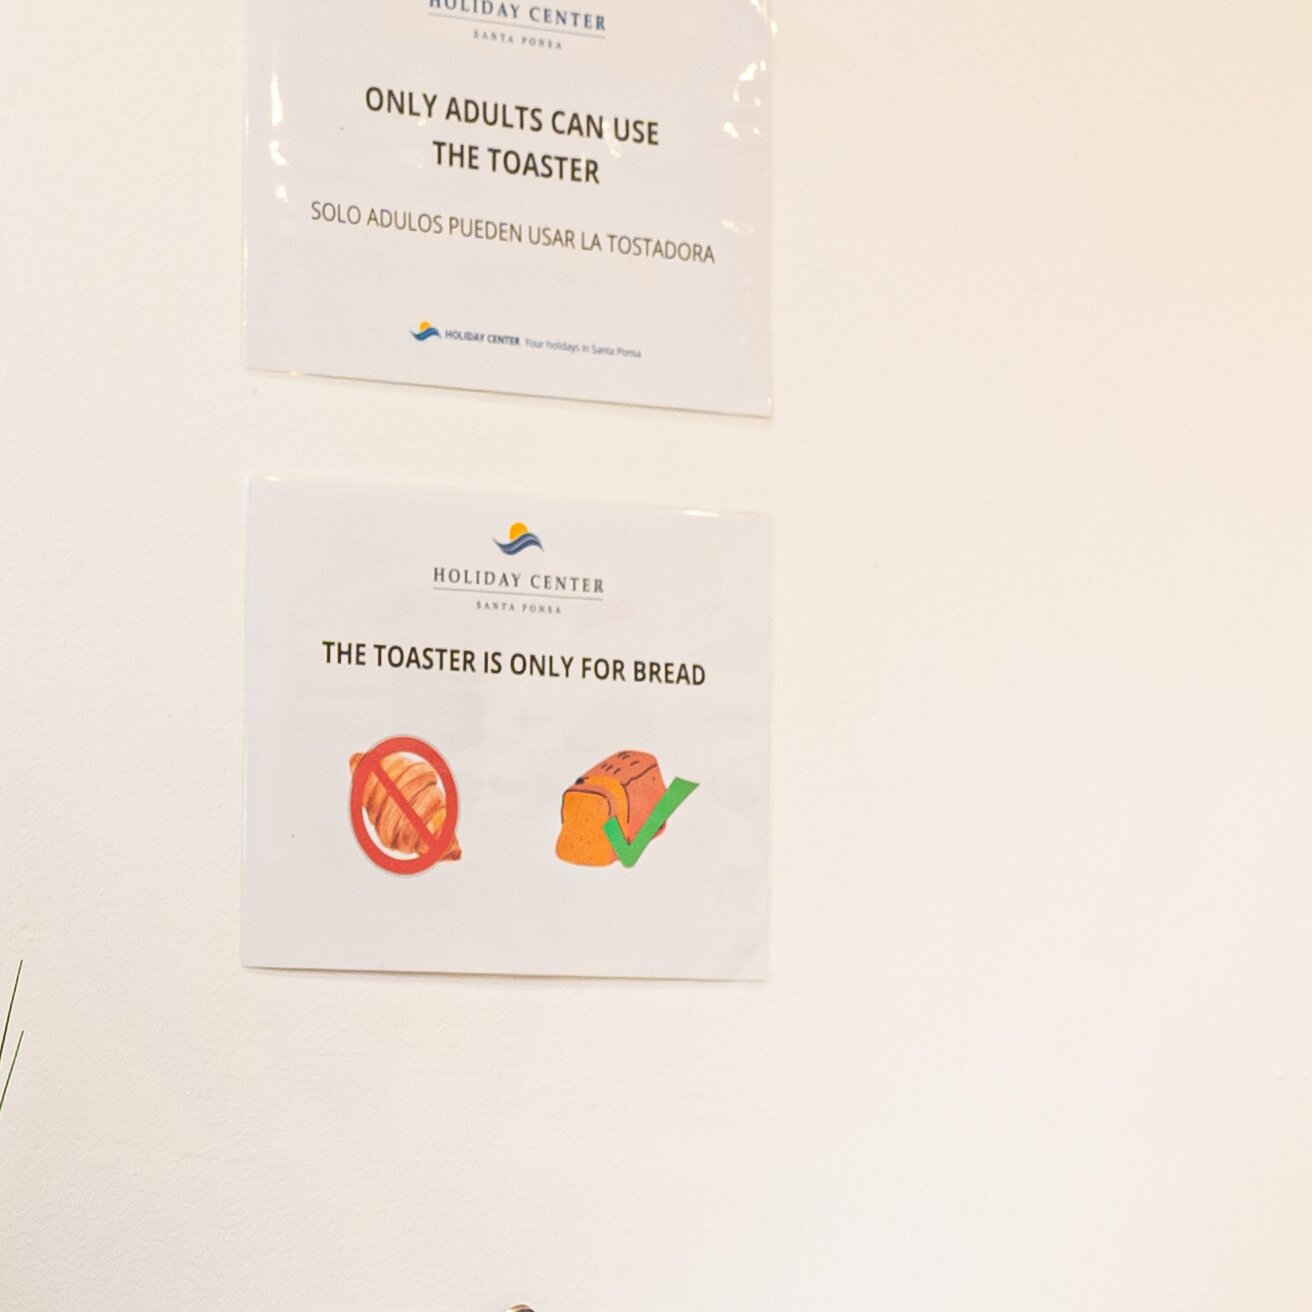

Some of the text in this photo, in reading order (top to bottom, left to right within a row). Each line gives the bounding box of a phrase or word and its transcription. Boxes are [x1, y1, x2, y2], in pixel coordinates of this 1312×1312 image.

[429, 0, 606, 31] HOLIDAY CENTER
[366, 86, 660, 146] ONLY ADULTS CAN USE
[434, 141, 600, 184] THE TOASTER
[311, 201, 716, 264] SOLO ADULOS PUEDEN USAR LA TOSTADORA
[446, 330, 484, 343] HOLIDAY
[488, 334, 520, 345] CENTER
[434, 567, 604, 593] HOLIDAY CENTER
[322, 640, 706, 686] THE TOASTER IS ONLY FOR BREAD
